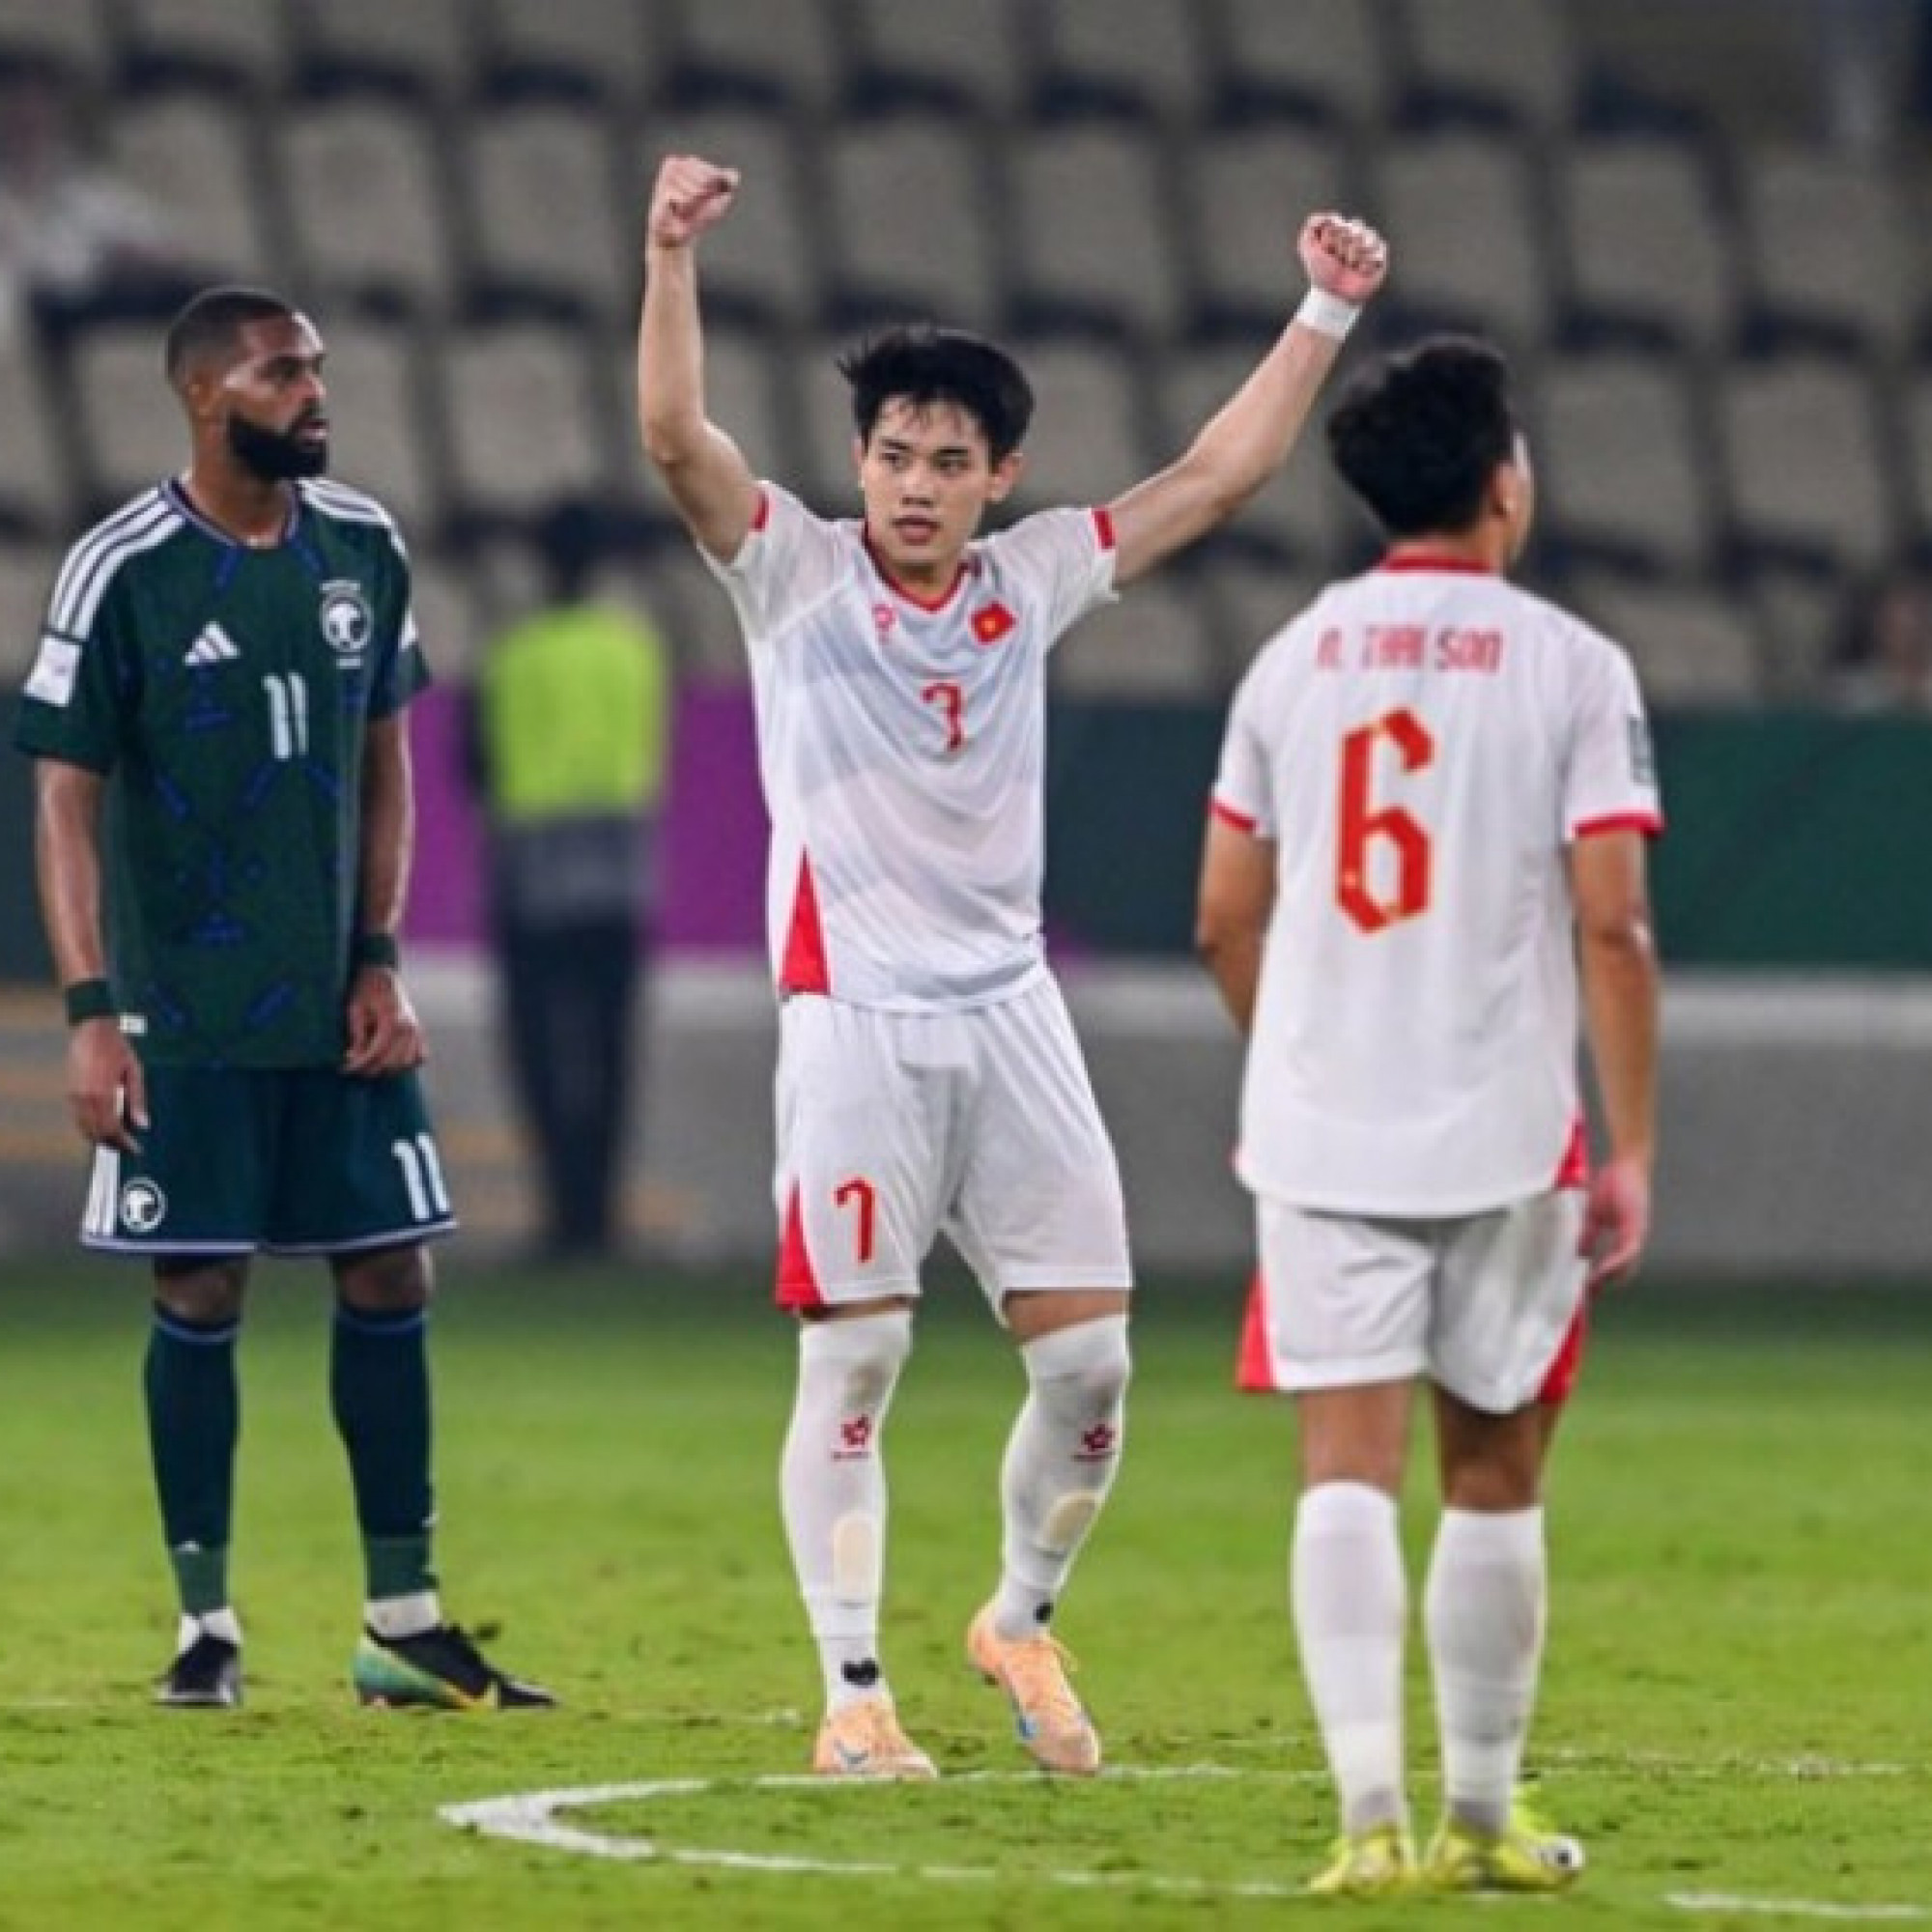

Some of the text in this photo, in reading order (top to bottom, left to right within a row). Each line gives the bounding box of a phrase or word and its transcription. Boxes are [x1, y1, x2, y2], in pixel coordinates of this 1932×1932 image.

[263, 671, 309, 760] 11
[1337, 707, 1435, 935] 6
[390, 1132, 454, 1221] 11
[832, 1177, 875, 1264] 7
